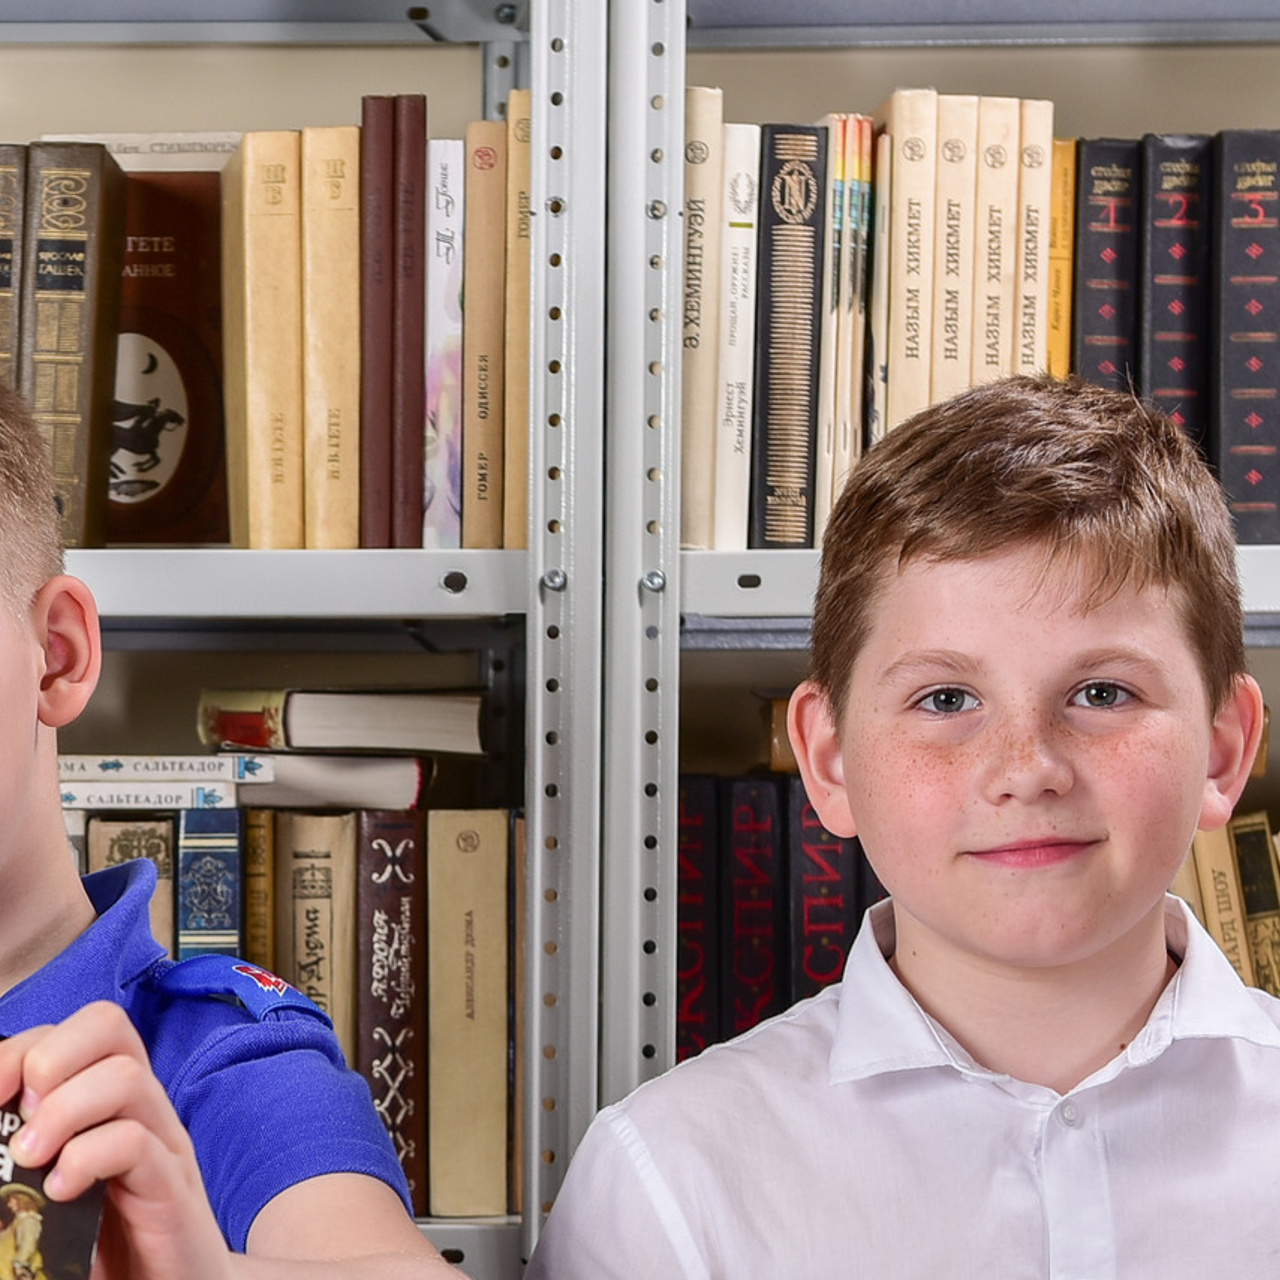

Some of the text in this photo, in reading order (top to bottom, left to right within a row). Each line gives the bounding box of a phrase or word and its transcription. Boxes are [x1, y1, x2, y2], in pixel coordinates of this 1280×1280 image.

[126, 236, 175, 252] ГЕТЕ
[517, 190, 530, 240] ГОМЕР
[683, 198, 706, 329] ХЕМИНГУЭЙ
[740, 246, 751, 300] РАССКАЗЫ
[904, 197, 922, 360] НАЗЫМ ХИКМЕТ
[943, 198, 962, 361] НАЗЫМ ХИКМЕТ
[984, 204, 1003, 367] НАЗЫМ ХИКМЕТ
[1020, 204, 1040, 367] НАЗЫМ ХИКМЕТ
[475, 353, 491, 502] ГОМЕР ОДИССЕЯ
[722, 382, 739, 428] Эрнест
[732, 380, 751, 456] Хемингуэй
[85, 793, 184, 806] САЛЬТЕАДОР
[131, 760, 226, 774] САЛЬТЕАДОР
[733, 803, 776, 1034] КСПИР
[1211, 868, 1233, 914] ШОУ
[463, 909, 476, 1020] АЛЕКСАНДР ДЮМА
